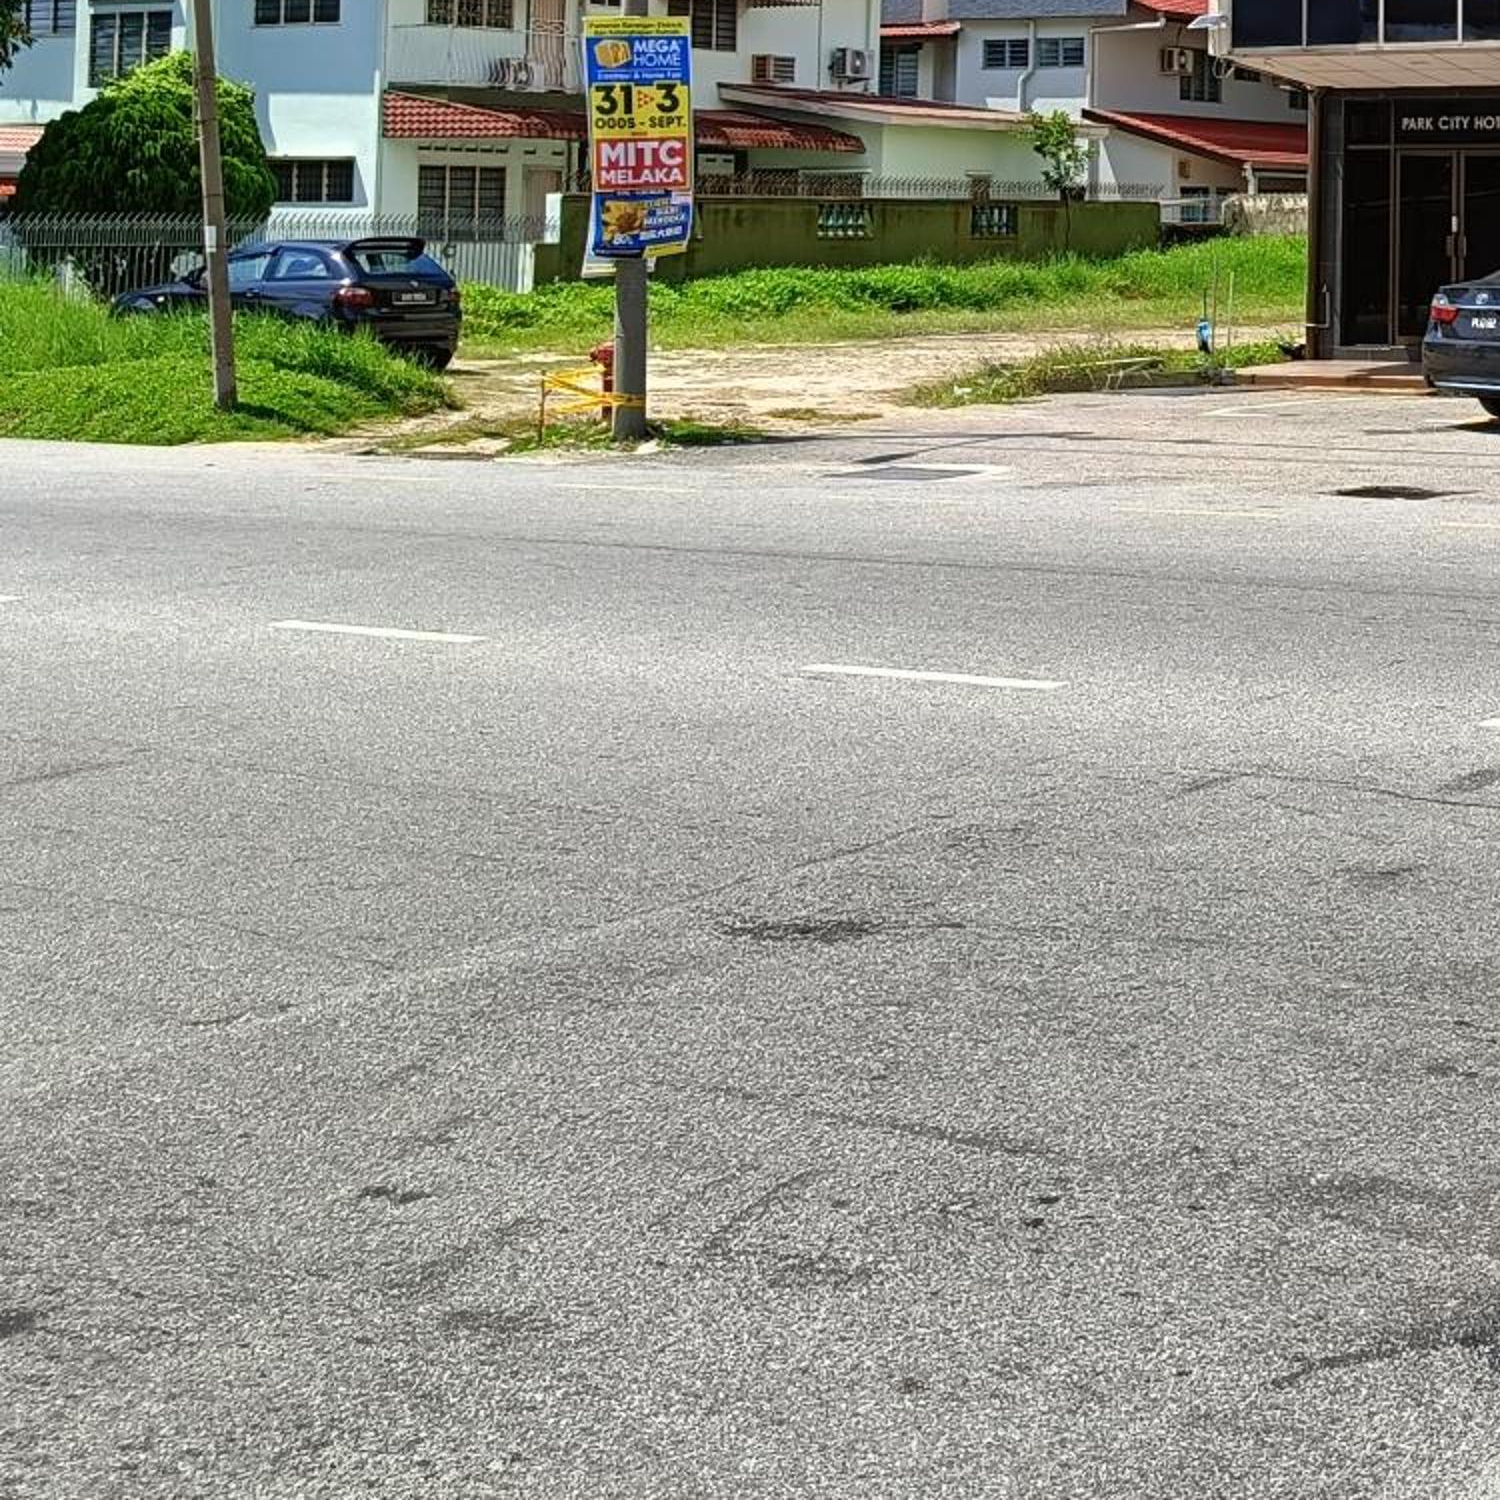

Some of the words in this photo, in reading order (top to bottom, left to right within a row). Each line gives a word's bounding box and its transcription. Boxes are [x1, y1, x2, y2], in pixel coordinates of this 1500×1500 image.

[633, 39, 681, 53] MEGA
[633, 53, 681, 67] HOME
[595, 84, 633, 115] 31
[656, 82, 680, 113] 3
[648, 114, 687, 129] SEPT.
[1401, 117, 1434, 131] PARK
[1438, 116, 1471, 131] CITY
[601, 140, 684, 168] MITC
[601, 167, 685, 185] MELAKA
